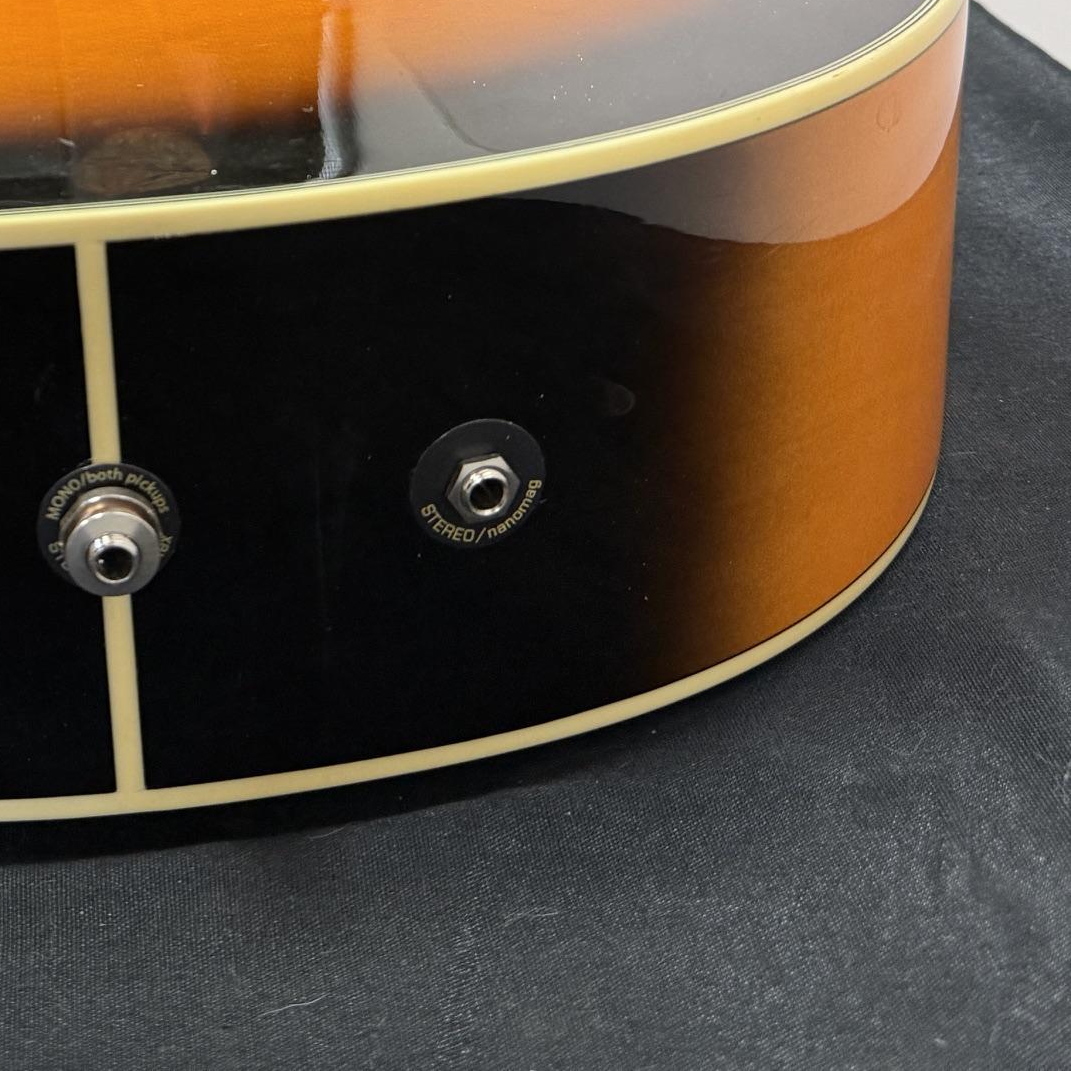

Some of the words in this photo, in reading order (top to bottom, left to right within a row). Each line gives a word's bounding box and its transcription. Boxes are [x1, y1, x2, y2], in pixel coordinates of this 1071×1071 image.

[46, 468, 123, 520] MONO/both
[125, 473, 169, 513] pickups
[421, 480, 542, 543] STEREO/nanomag
